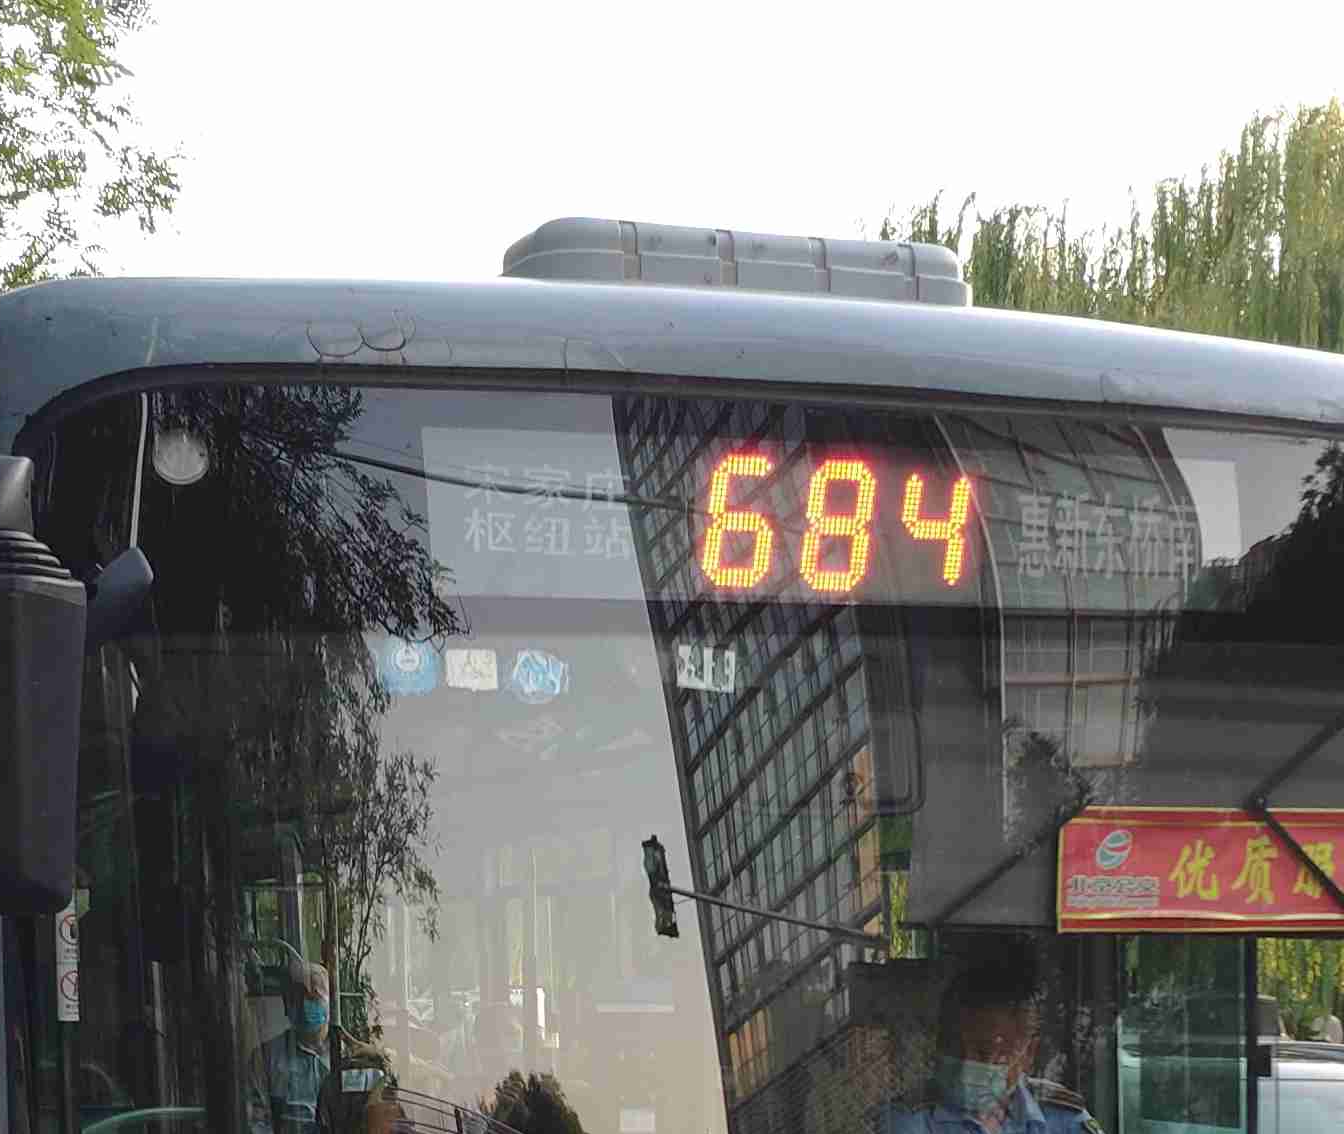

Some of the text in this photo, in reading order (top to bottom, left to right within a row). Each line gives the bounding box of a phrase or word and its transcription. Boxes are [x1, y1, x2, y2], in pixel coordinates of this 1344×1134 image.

[464, 508, 633, 560] 枢纽站
[696, 452, 975, 594] 684
